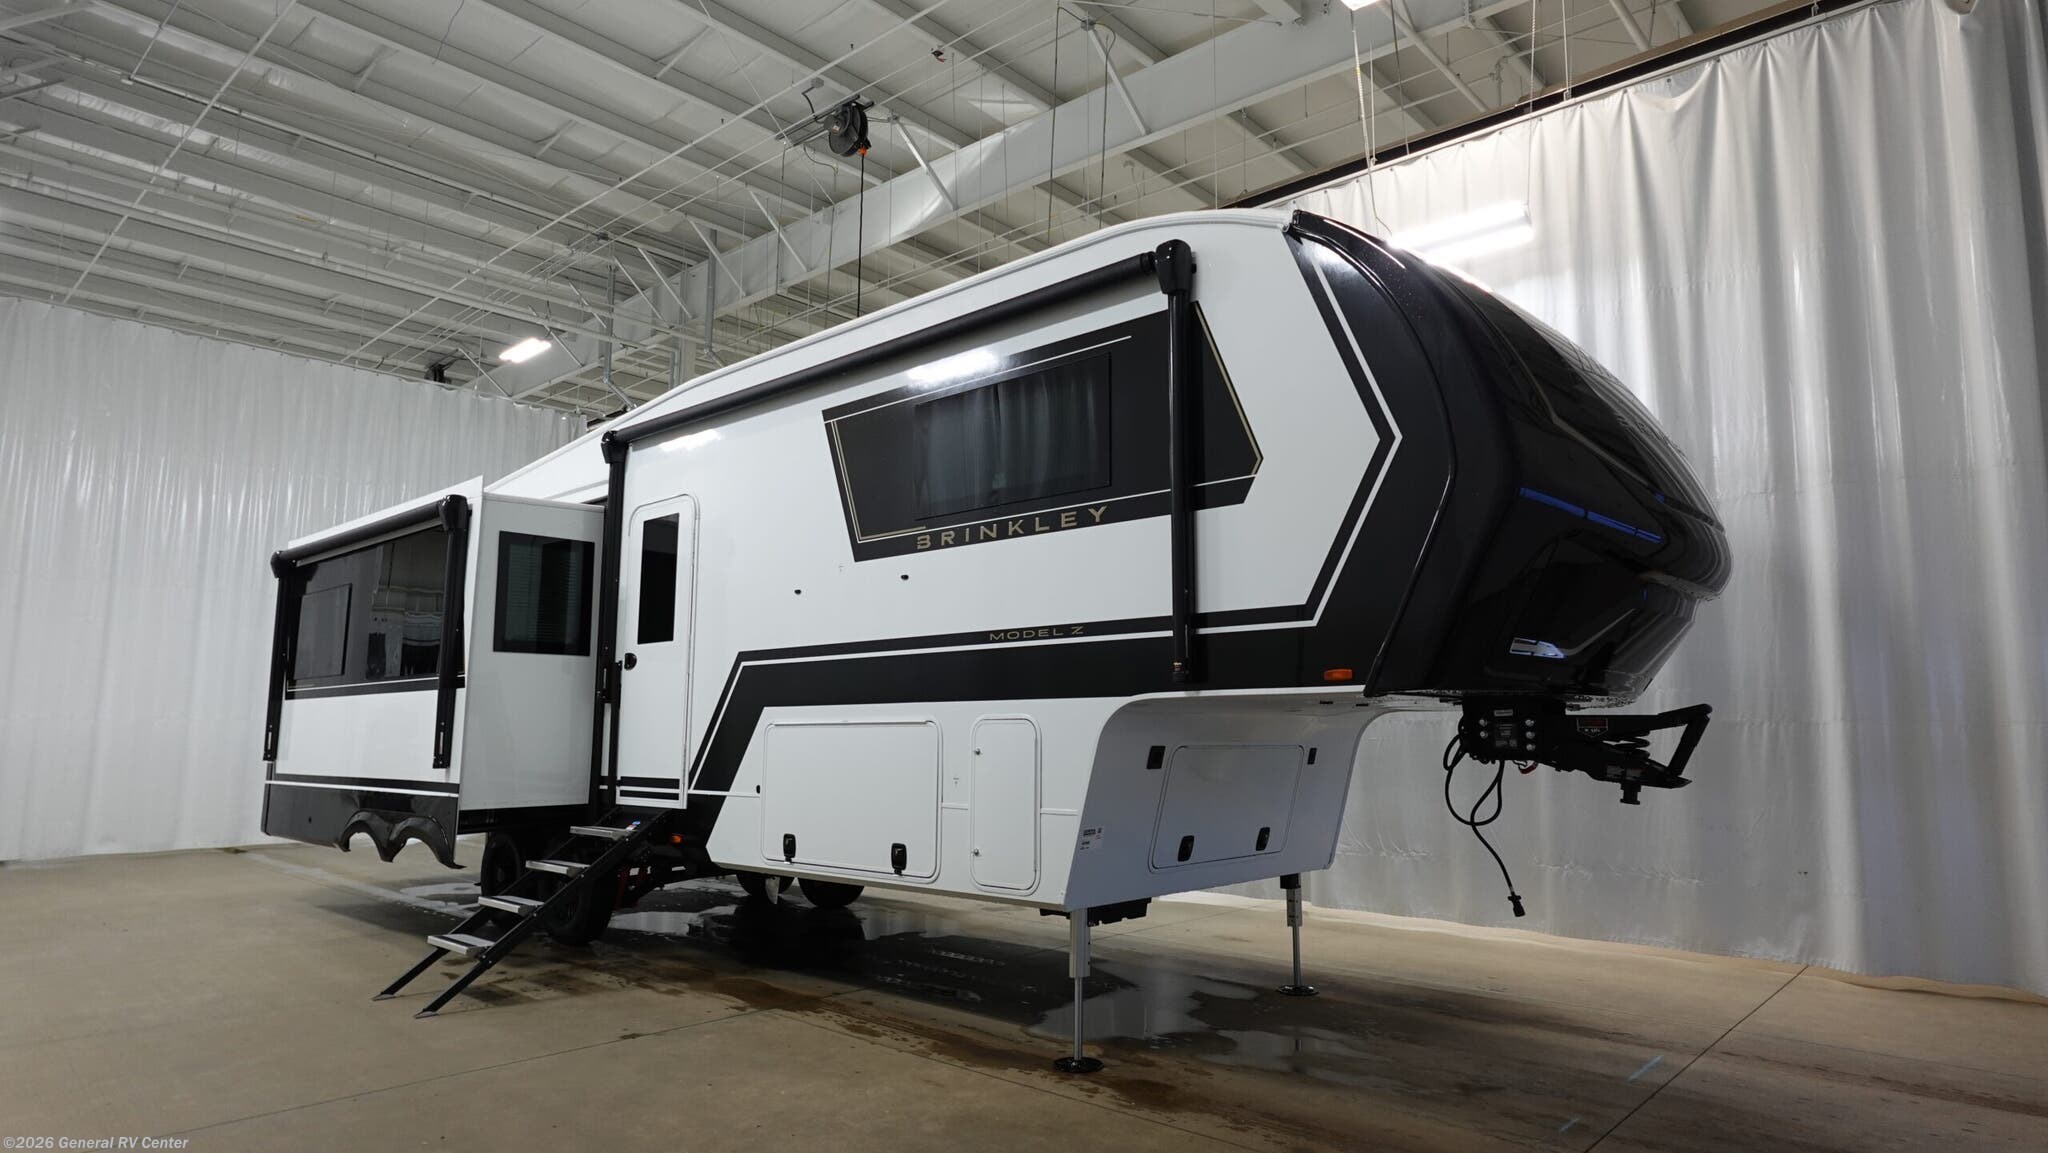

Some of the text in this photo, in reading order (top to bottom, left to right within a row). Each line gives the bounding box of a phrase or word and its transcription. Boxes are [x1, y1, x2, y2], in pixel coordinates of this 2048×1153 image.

[916, 505, 1108, 550] BRINKLEY
[989, 625, 1084, 641] MODEL Z
